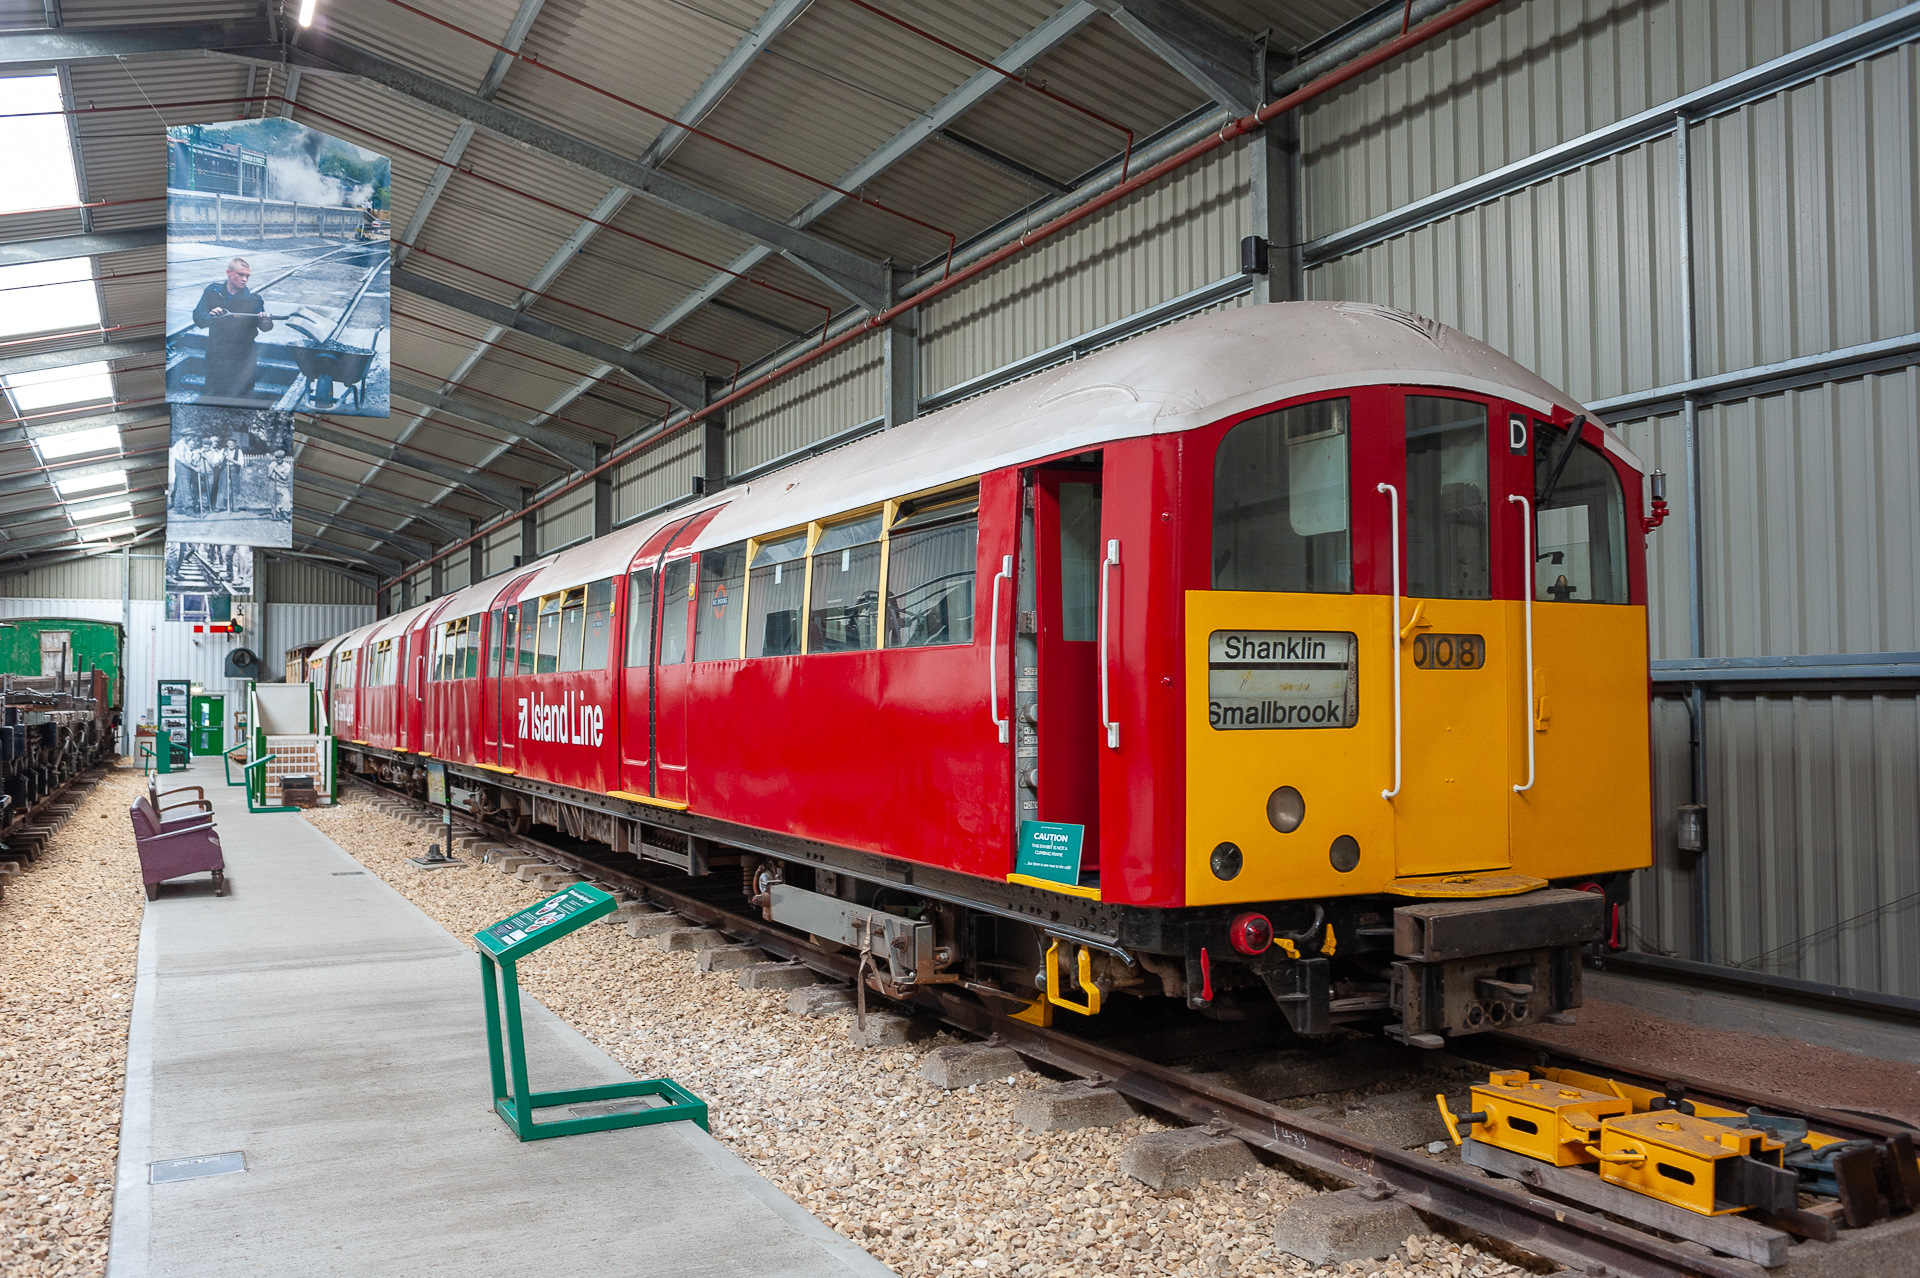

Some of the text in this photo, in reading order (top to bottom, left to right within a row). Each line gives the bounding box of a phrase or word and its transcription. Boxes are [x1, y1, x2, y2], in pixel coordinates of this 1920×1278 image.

[1510, 419, 1527, 448] D
[1224, 635, 1326, 660] Shanklin
[1414, 637, 1475, 667] 008
[531, 689, 604, 748] Island Line
[1209, 700, 1340, 725] Smallbrook
[1033, 832, 1068, 842] CAUTION
